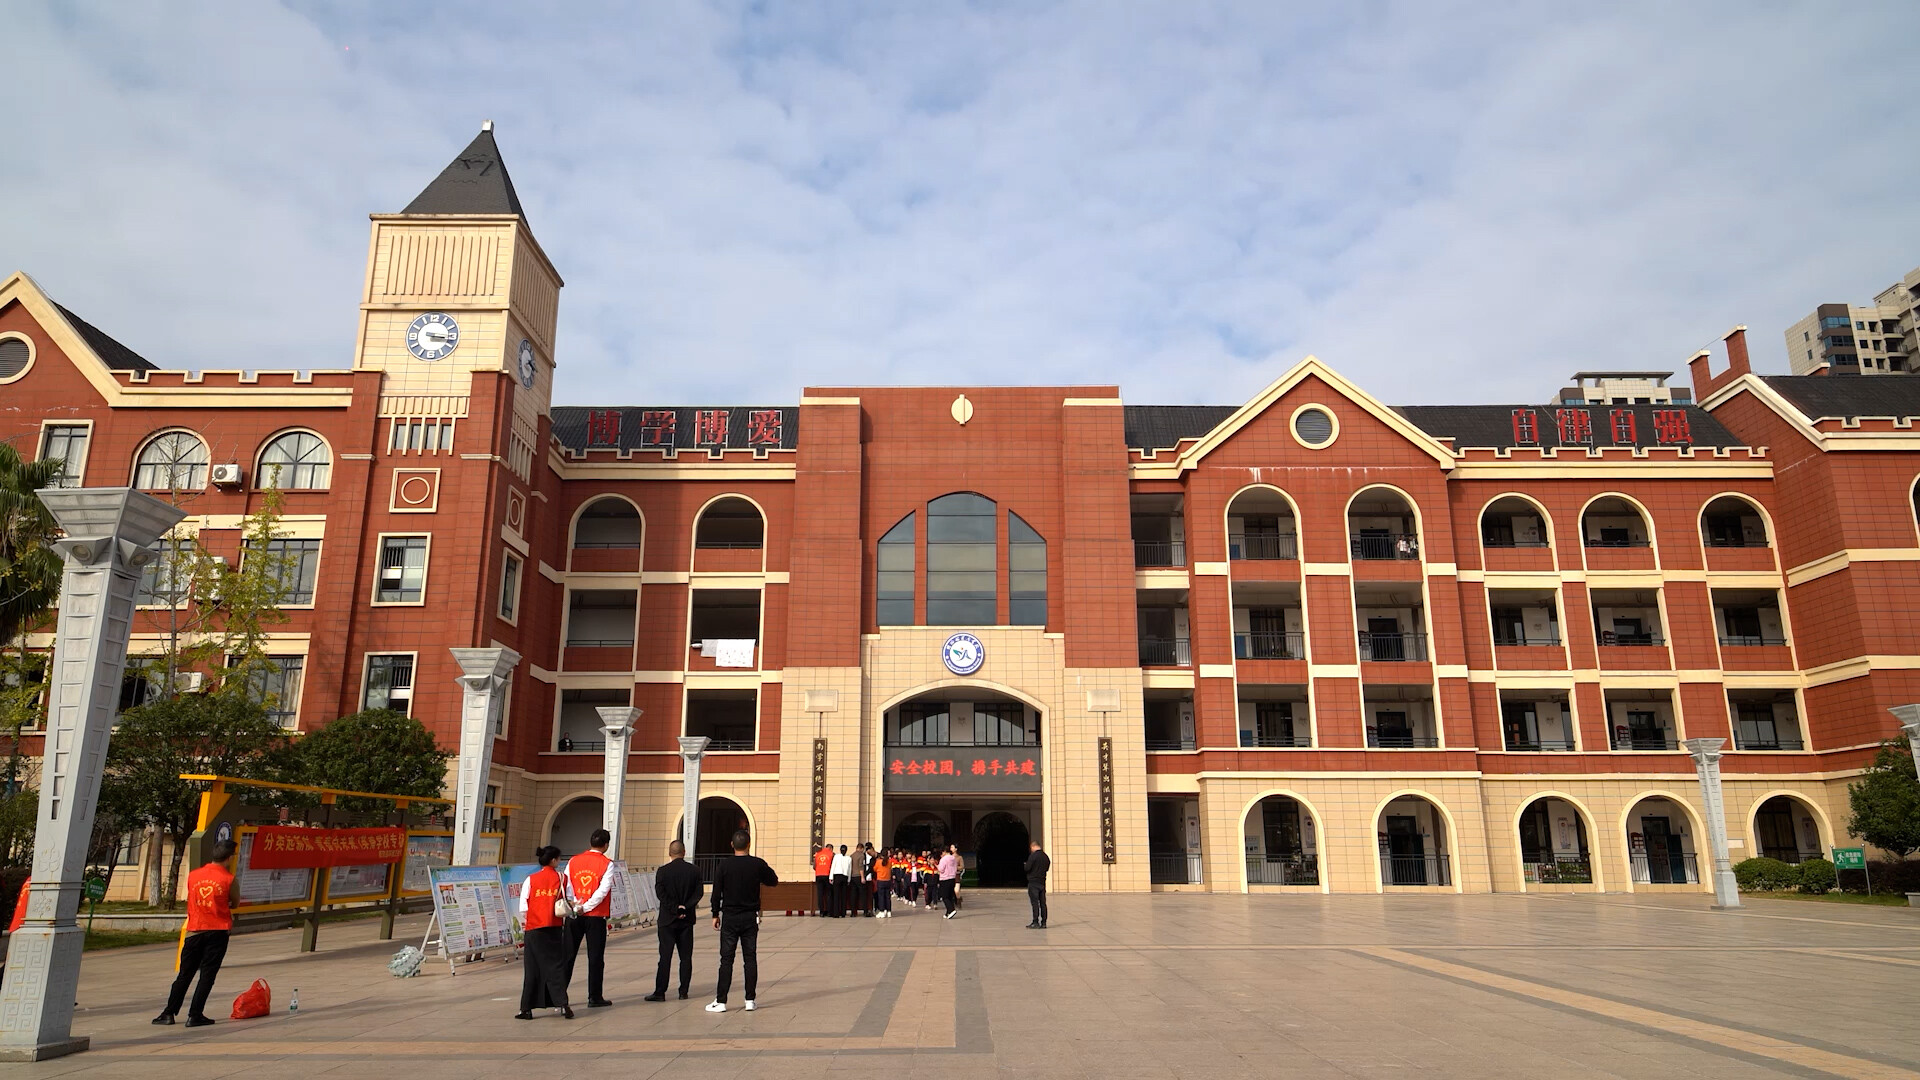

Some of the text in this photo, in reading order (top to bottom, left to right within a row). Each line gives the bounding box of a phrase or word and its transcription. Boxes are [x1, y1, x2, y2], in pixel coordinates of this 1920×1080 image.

[430, 314, 440, 322] 12
[408, 332, 418, 340] 9
[448, 332, 457, 340] 3
[426, 350, 435, 359] 6
[587, 409, 783, 444] 博学博爱
[1511, 407, 1694, 444] 自律自强
